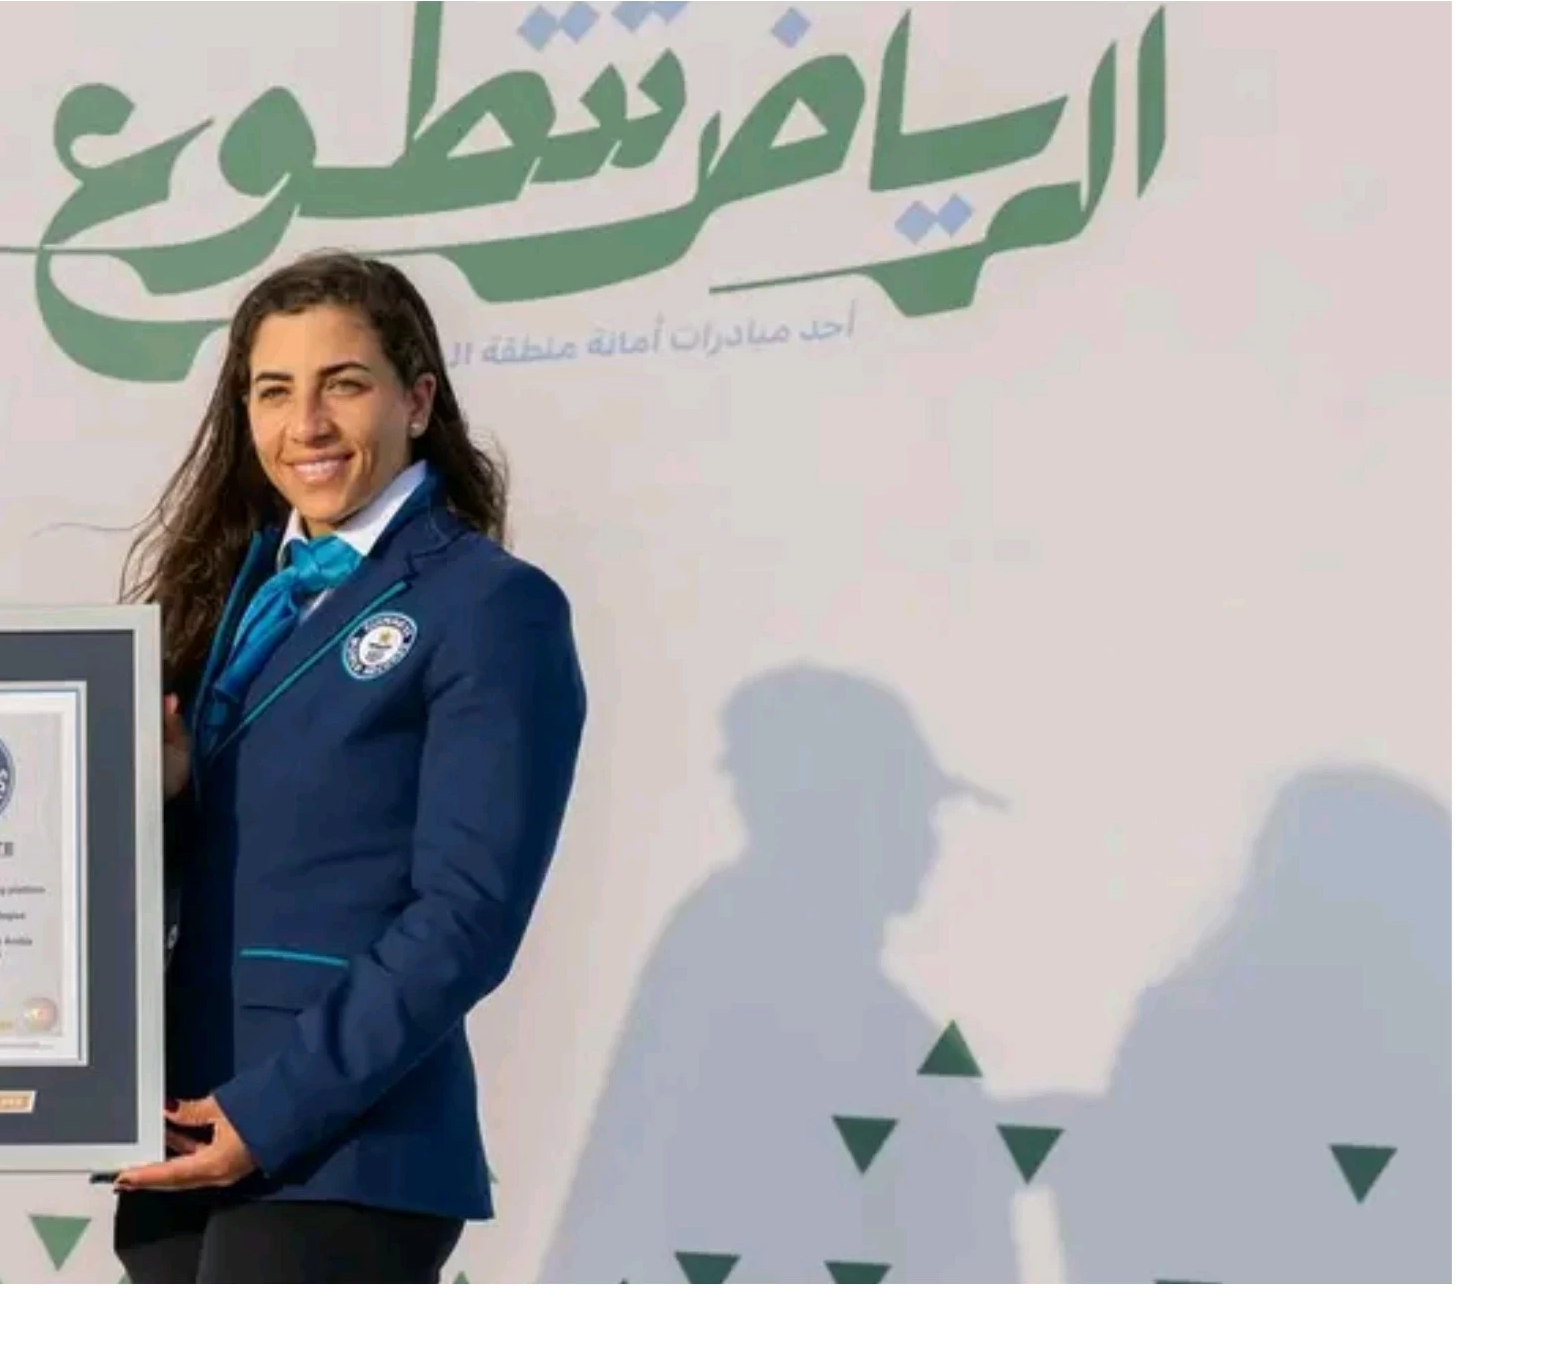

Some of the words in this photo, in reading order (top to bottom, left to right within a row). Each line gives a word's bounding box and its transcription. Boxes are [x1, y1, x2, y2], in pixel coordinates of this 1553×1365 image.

[481, 333, 578, 365] منطقة
[587, 312, 663, 356] أمانة
[670, 315, 790, 356] مبادرات
